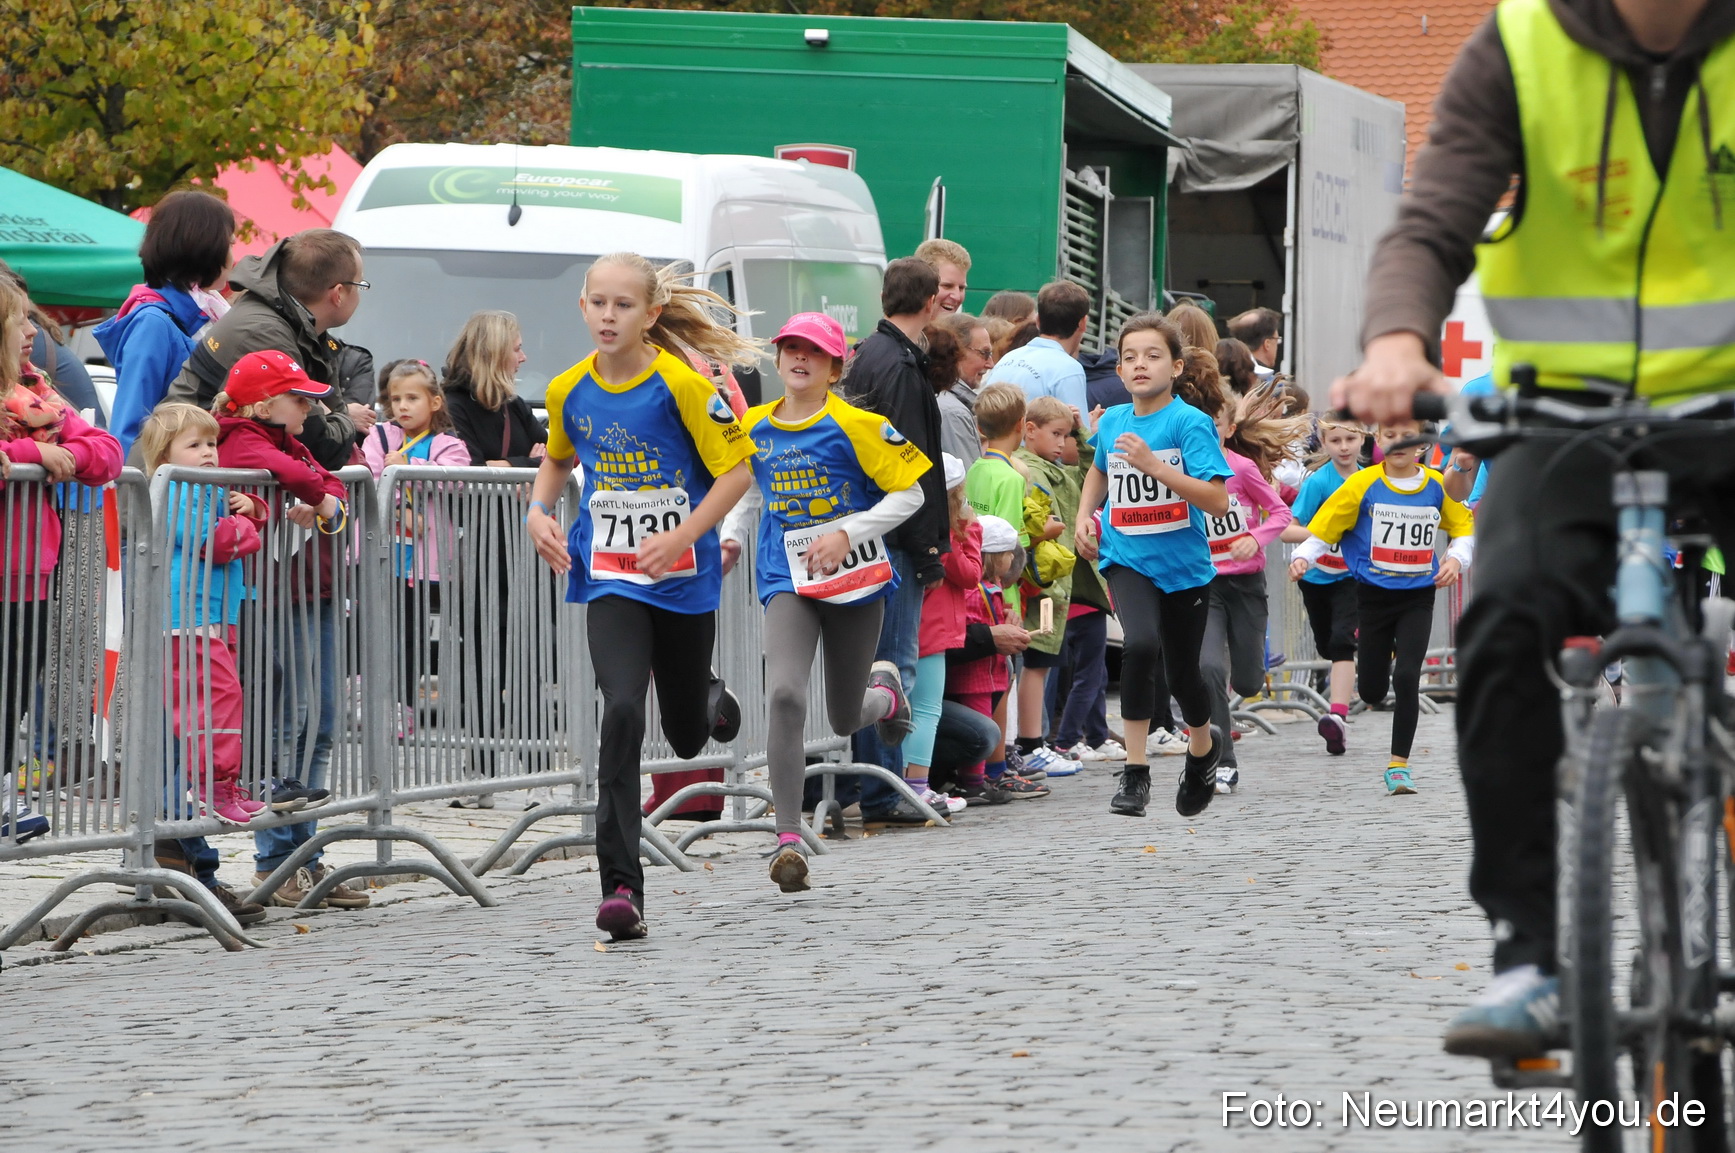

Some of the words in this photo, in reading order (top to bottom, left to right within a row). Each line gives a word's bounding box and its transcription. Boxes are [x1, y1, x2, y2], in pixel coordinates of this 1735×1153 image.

[512, 172, 613, 187] Europcar
[496, 187, 549, 199] moving
[553, 189, 585, 199] your
[588, 191, 620, 203] way
[643, 472, 662, 482] 2014
[814, 486, 832, 497] 2014
[590, 499, 621, 509] PARTL
[622, 498, 671, 510] Neumarkt
[1121, 510, 1172, 524] Katharina
[1375, 510, 1399, 519] PARTL
[1400, 512, 1431, 520] Neumarkt
[1381, 521, 1435, 546] 7196
[617, 556, 637, 571] Vic
[1393, 551, 1418, 563] Elena
